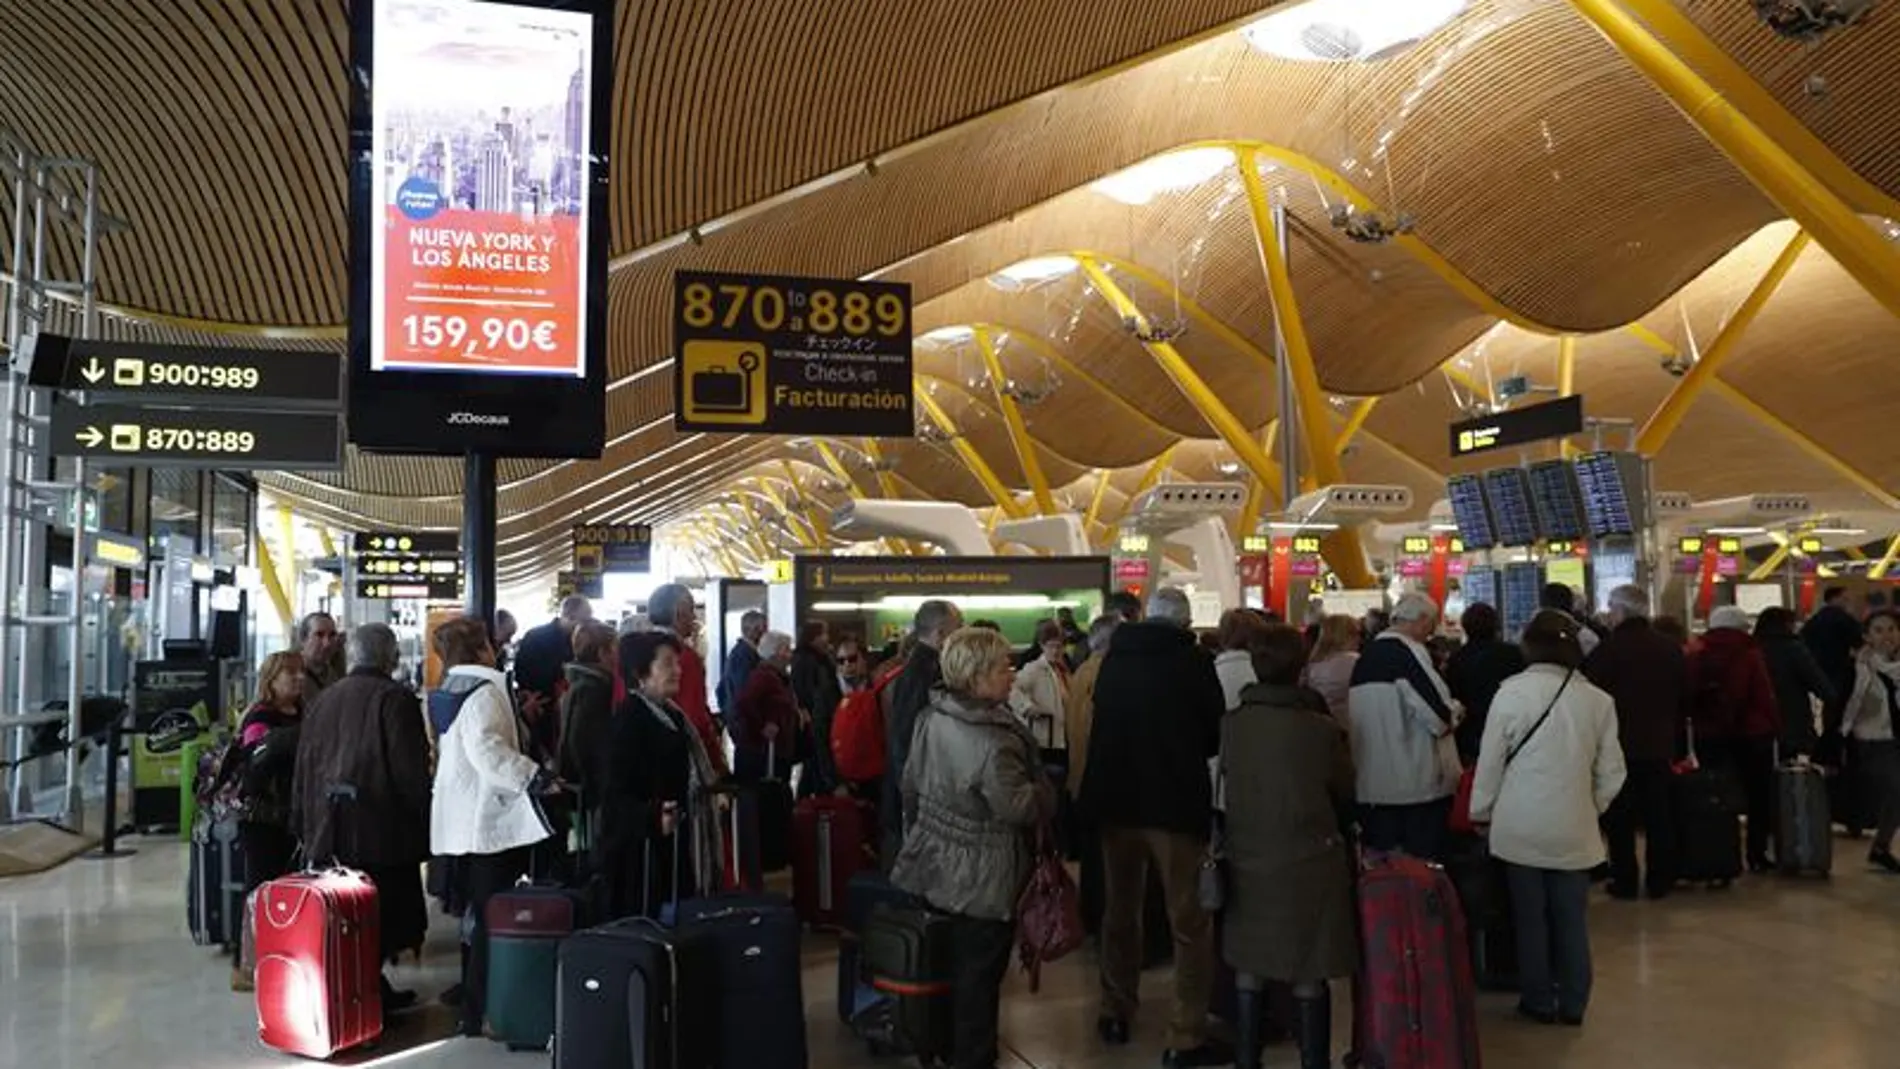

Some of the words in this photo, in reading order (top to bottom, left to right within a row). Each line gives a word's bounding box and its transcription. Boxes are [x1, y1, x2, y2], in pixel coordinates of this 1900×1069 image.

[409, 228, 479, 249] NUEVA
[482, 232, 536, 252] YORK
[541, 236, 555, 254] Y
[412, 248, 453, 267] LOS
[457, 245, 551, 274] ÁNGELES
[682, 282, 786, 331] 870
[789, 317, 804, 332] a
[808, 289, 905, 336] 889
[402, 315, 558, 355] 159,90€
[773, 384, 908, 410] Facturación
[447, 412, 510, 424] JCDecaux
